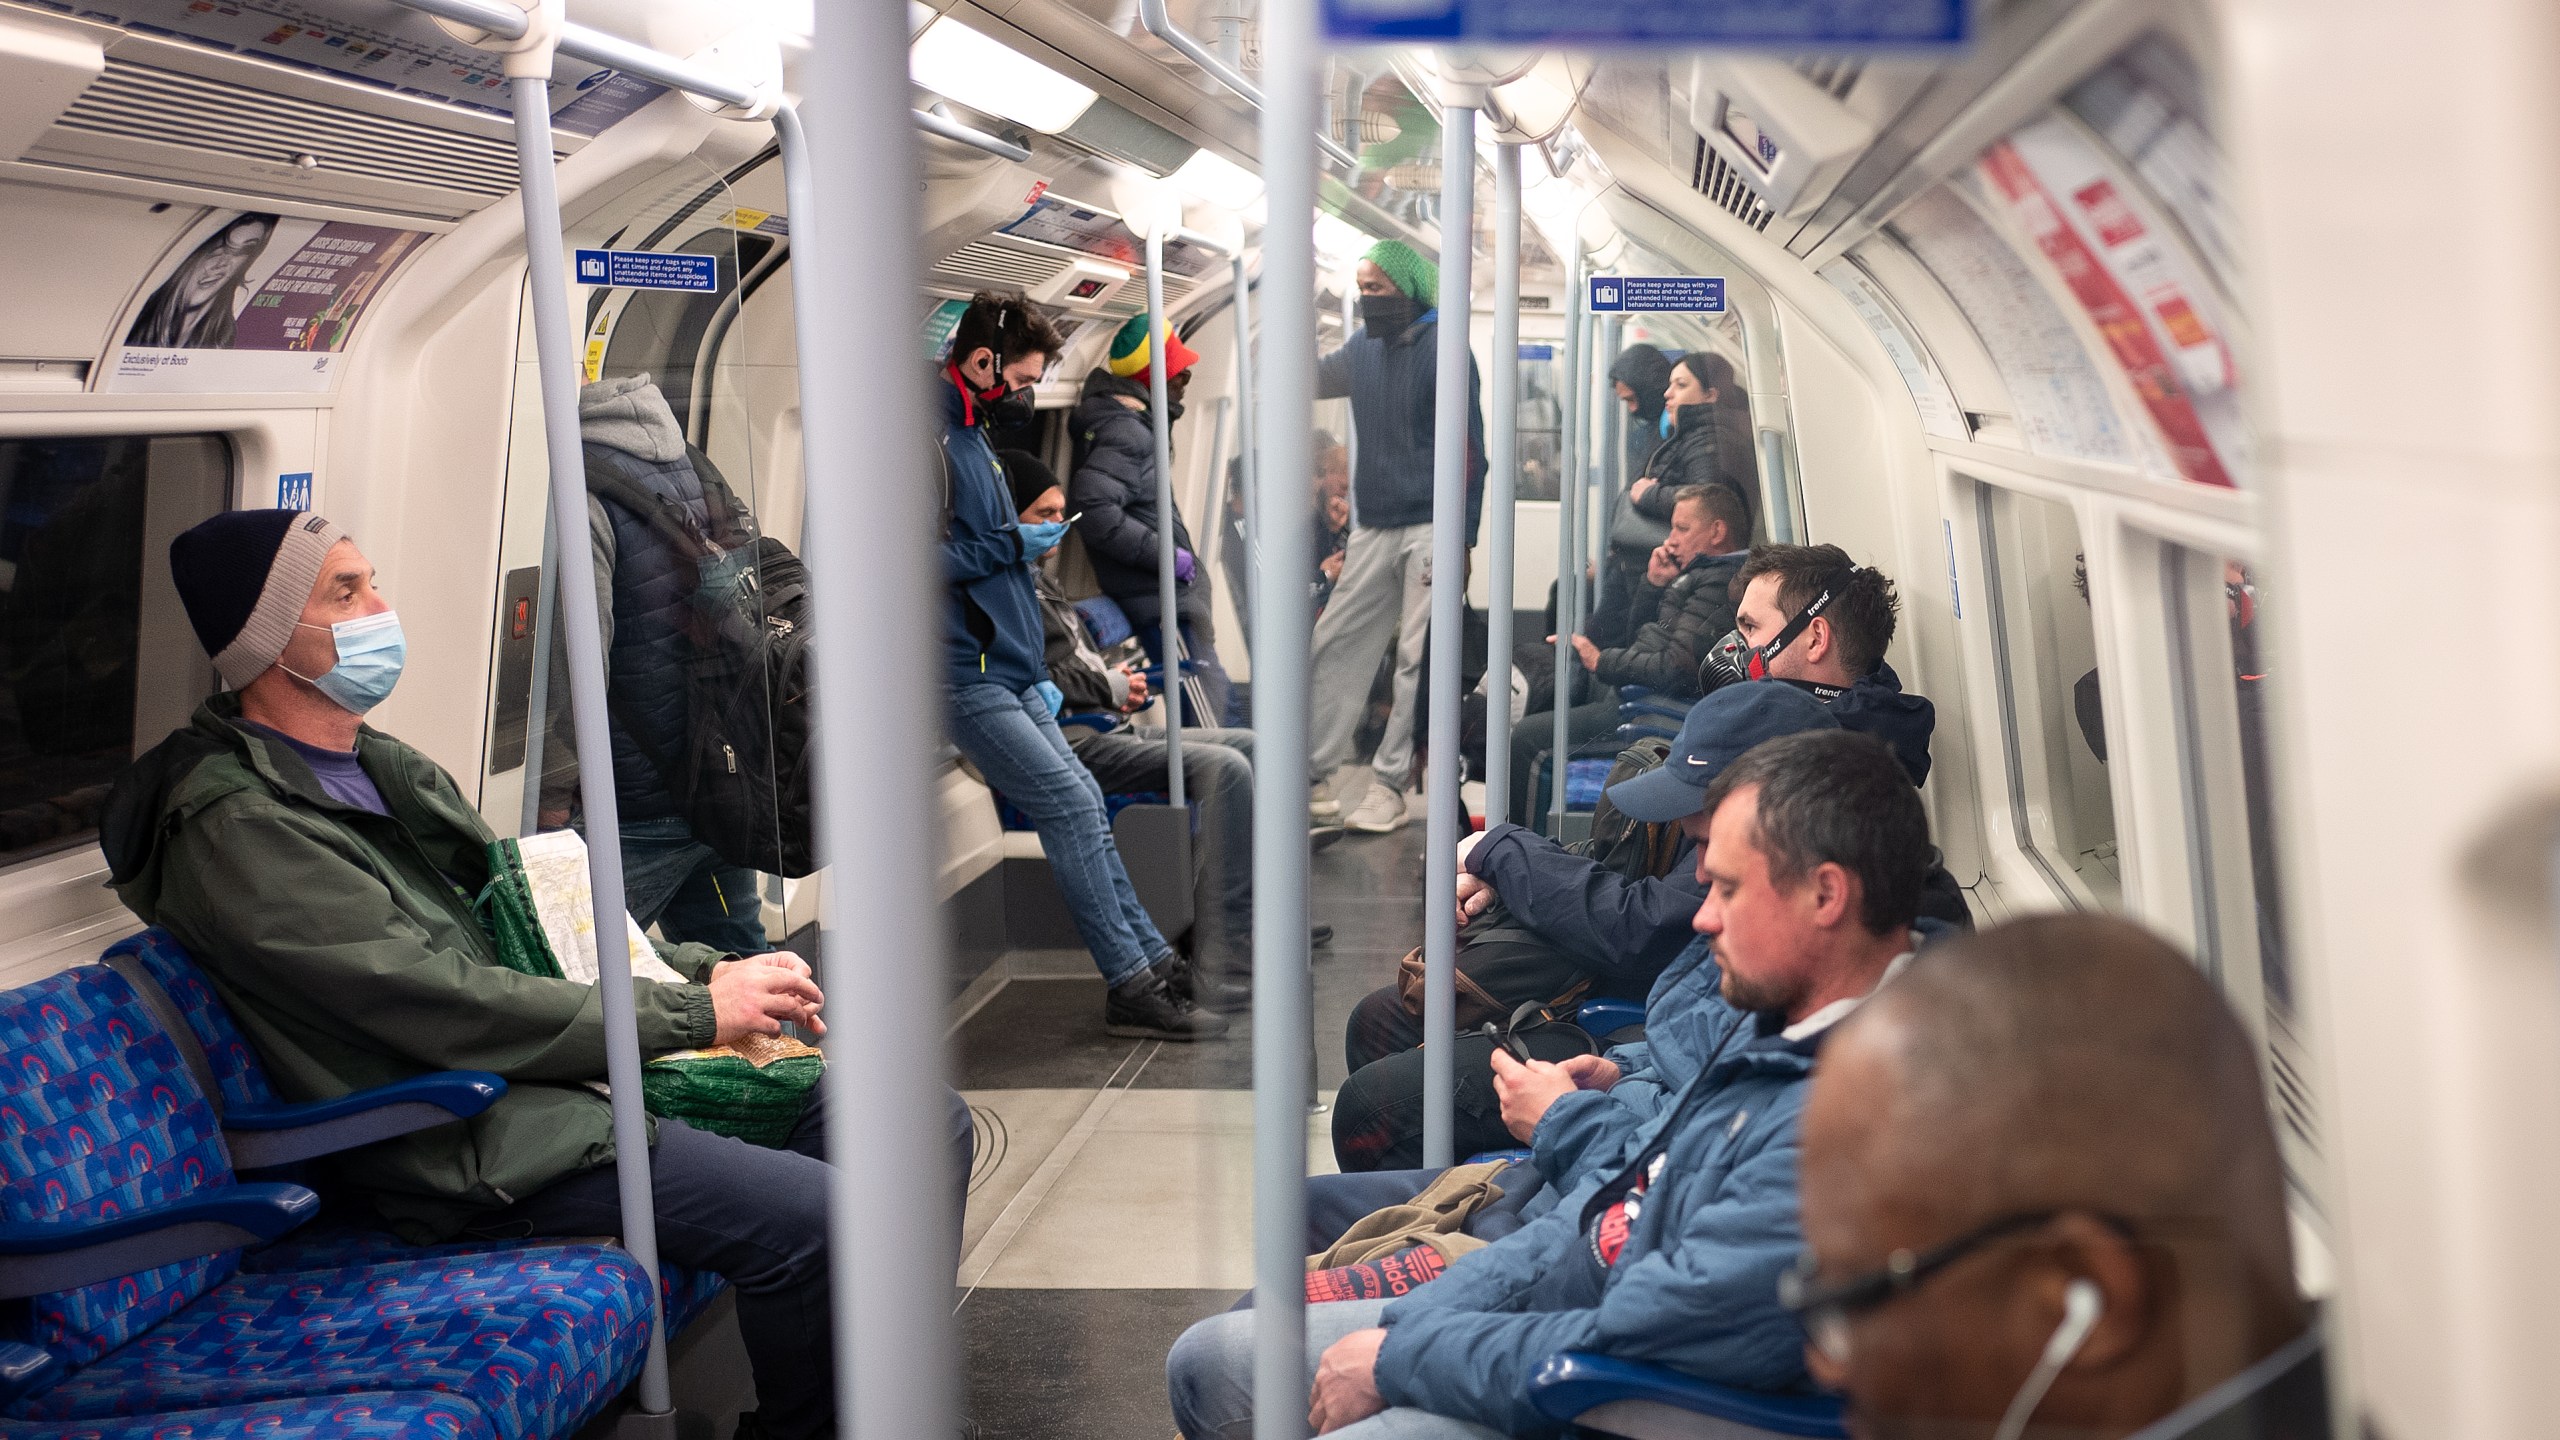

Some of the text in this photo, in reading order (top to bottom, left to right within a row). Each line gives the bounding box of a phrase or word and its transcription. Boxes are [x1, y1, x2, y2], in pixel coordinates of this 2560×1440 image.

[614, 276, 644, 284] behaviour
[676, 273, 708, 281] suspicious
[122, 352, 189, 368] Exclusively at Boots
[1807, 590, 1831, 616] trend
[1814, 686, 1840, 698] trend
